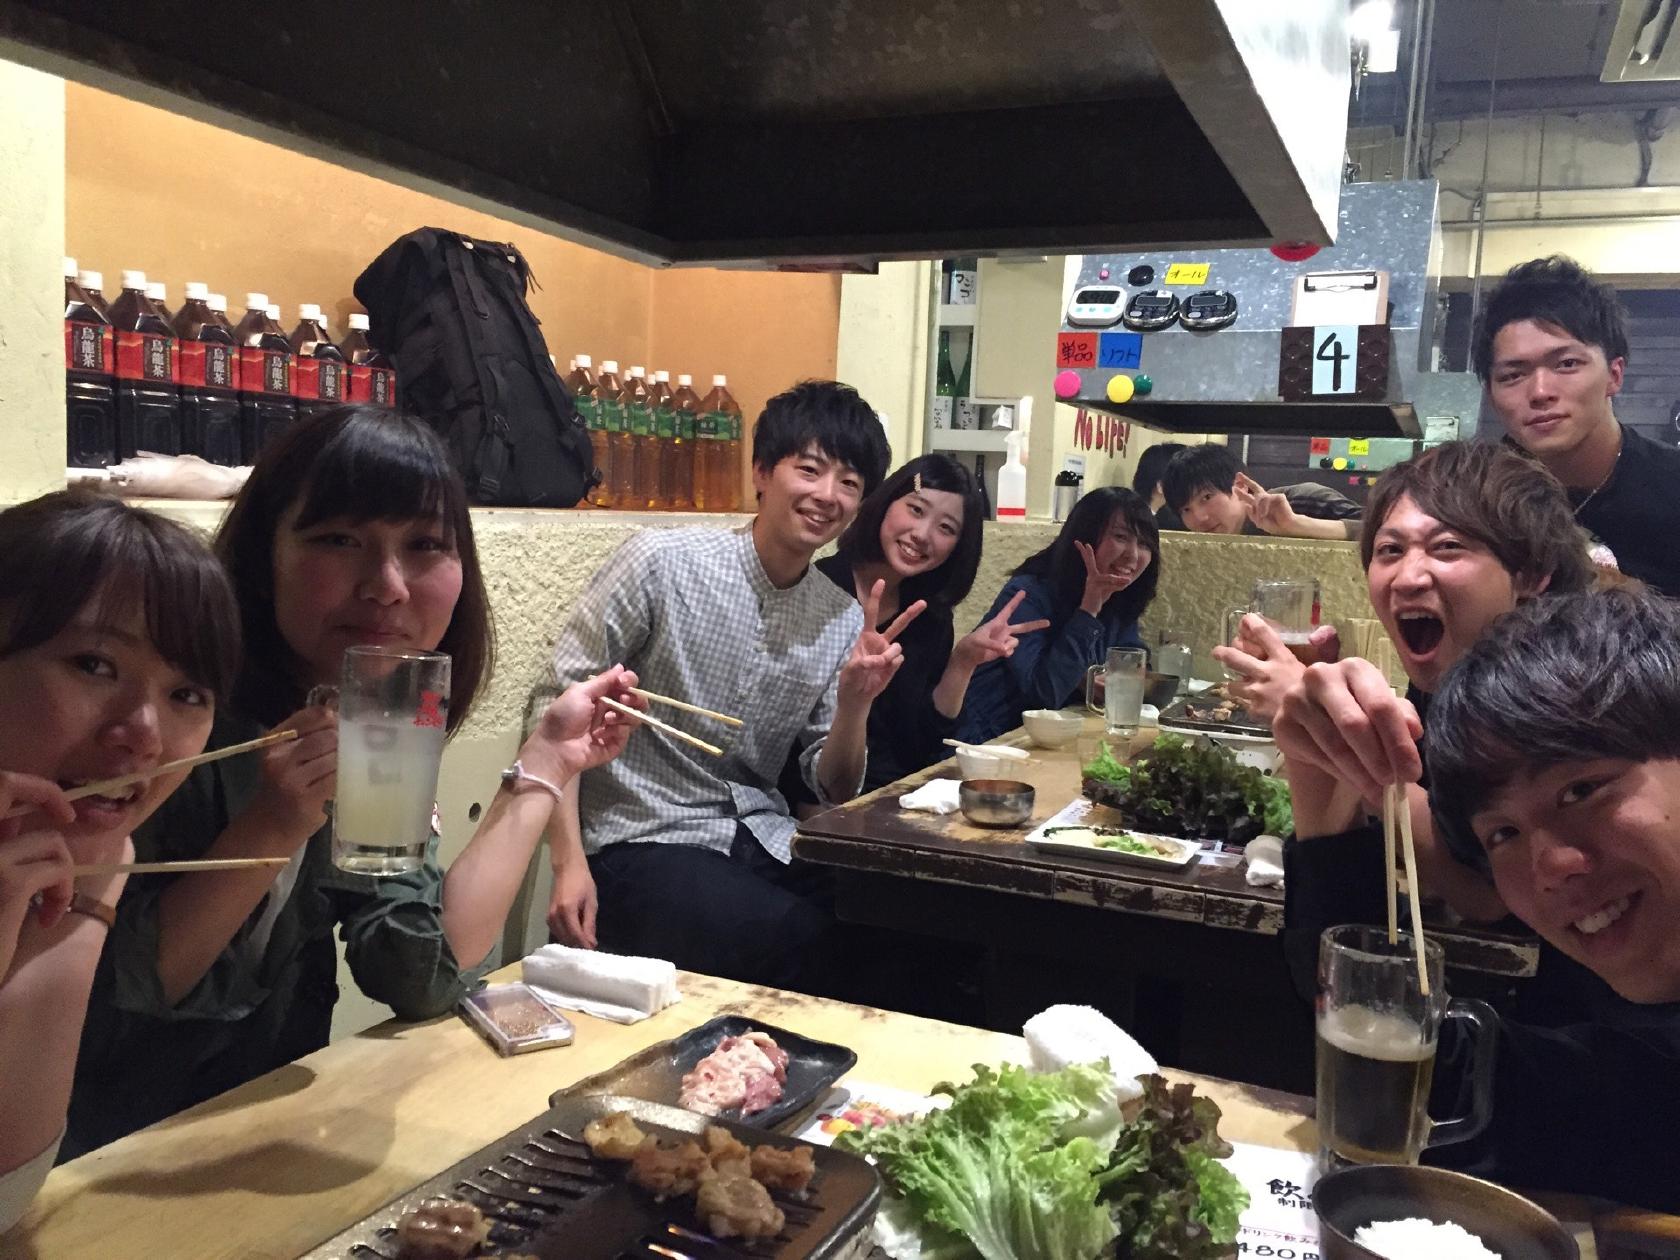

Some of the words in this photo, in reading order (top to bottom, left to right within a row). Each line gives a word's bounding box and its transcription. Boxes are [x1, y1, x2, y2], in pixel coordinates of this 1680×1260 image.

[1170, 269, 1206, 279] オール
[80, 326, 95, 368] 烏龍茶
[151, 338, 164, 378] 烏龍茶
[213, 347, 226, 385] 烏龍茶
[1316, 332, 1351, 392] 4
[271, 355, 283, 391] 烏龍茶
[1265, 1178, 1313, 1201] 飲
